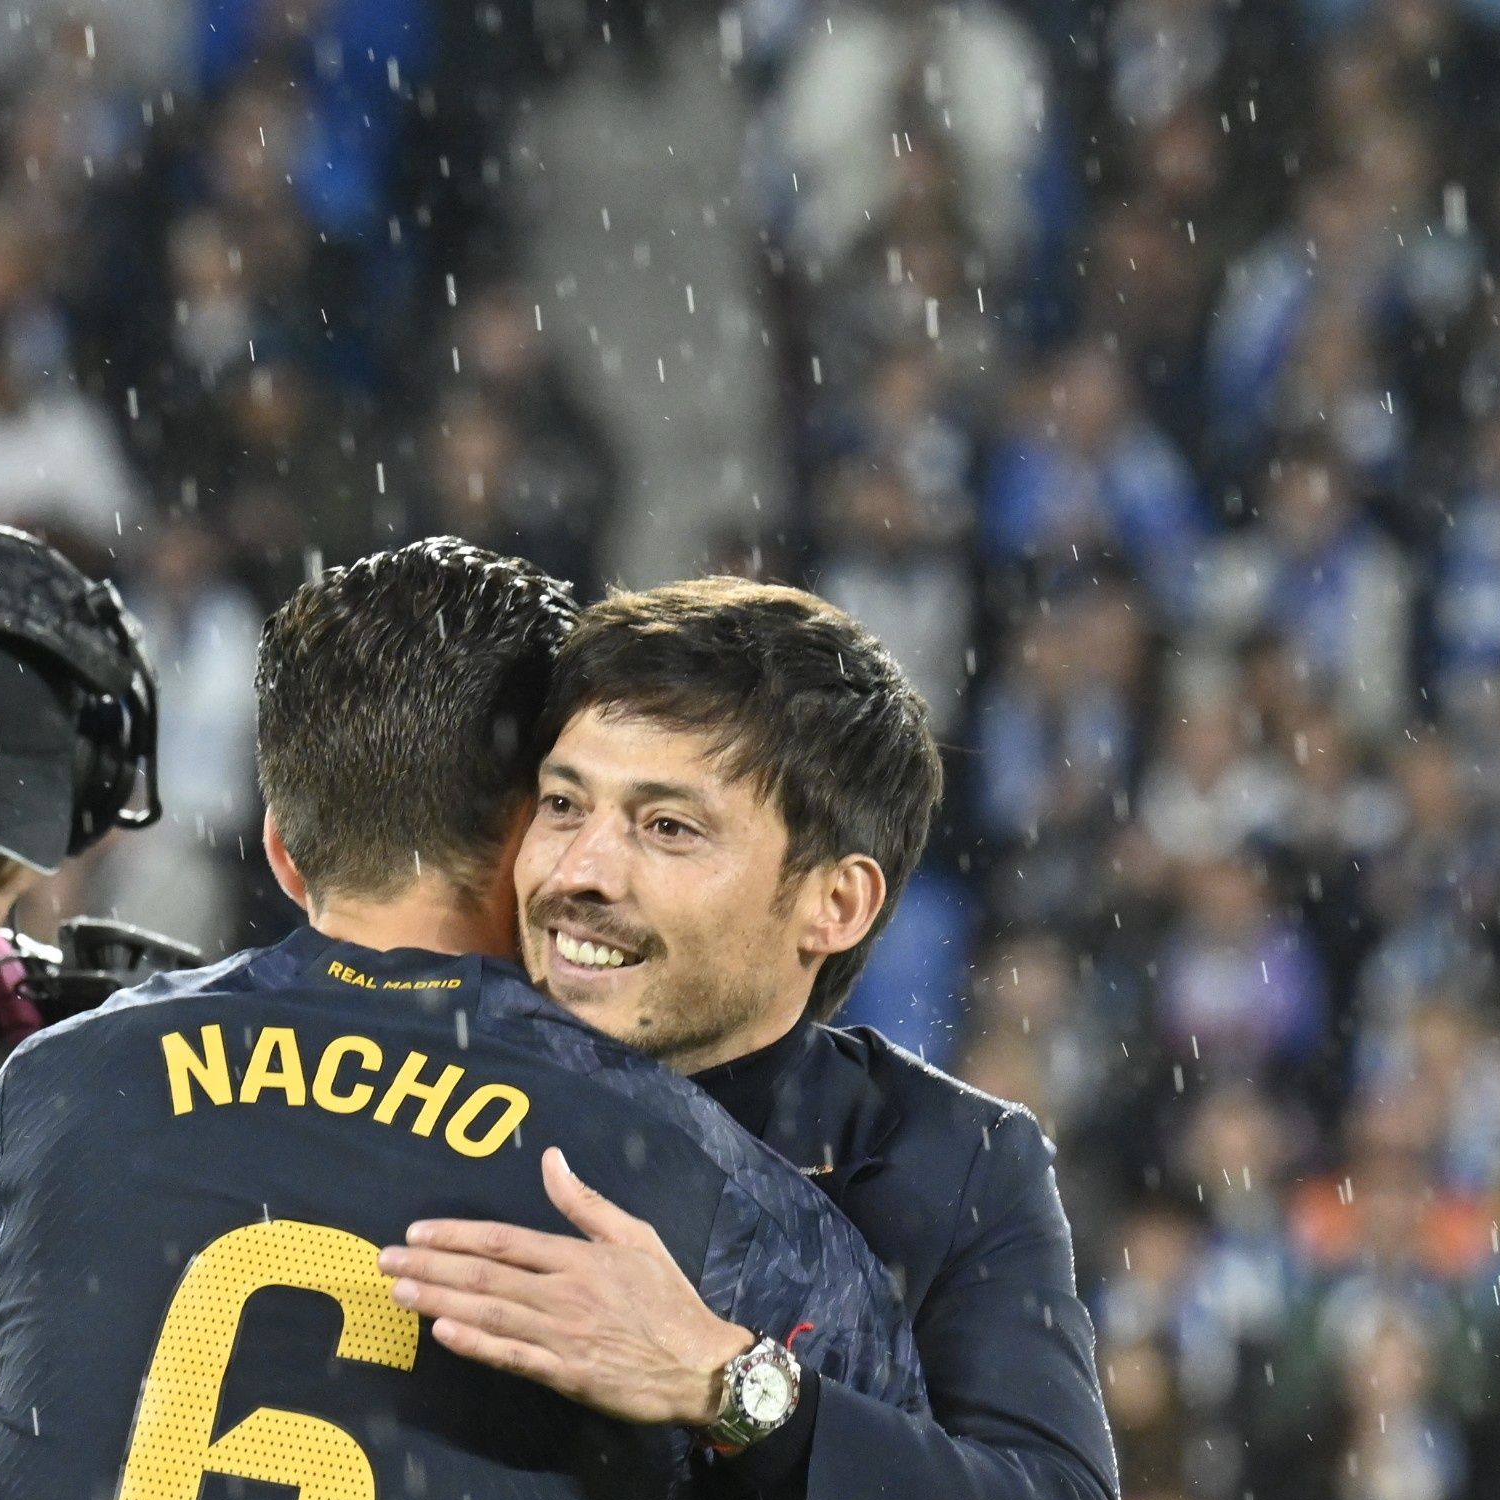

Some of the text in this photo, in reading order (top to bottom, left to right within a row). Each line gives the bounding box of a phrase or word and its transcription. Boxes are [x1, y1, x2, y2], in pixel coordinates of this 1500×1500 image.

[327, 960, 462, 990] REAL MADRID
[161, 1023, 530, 1159] NACHO
